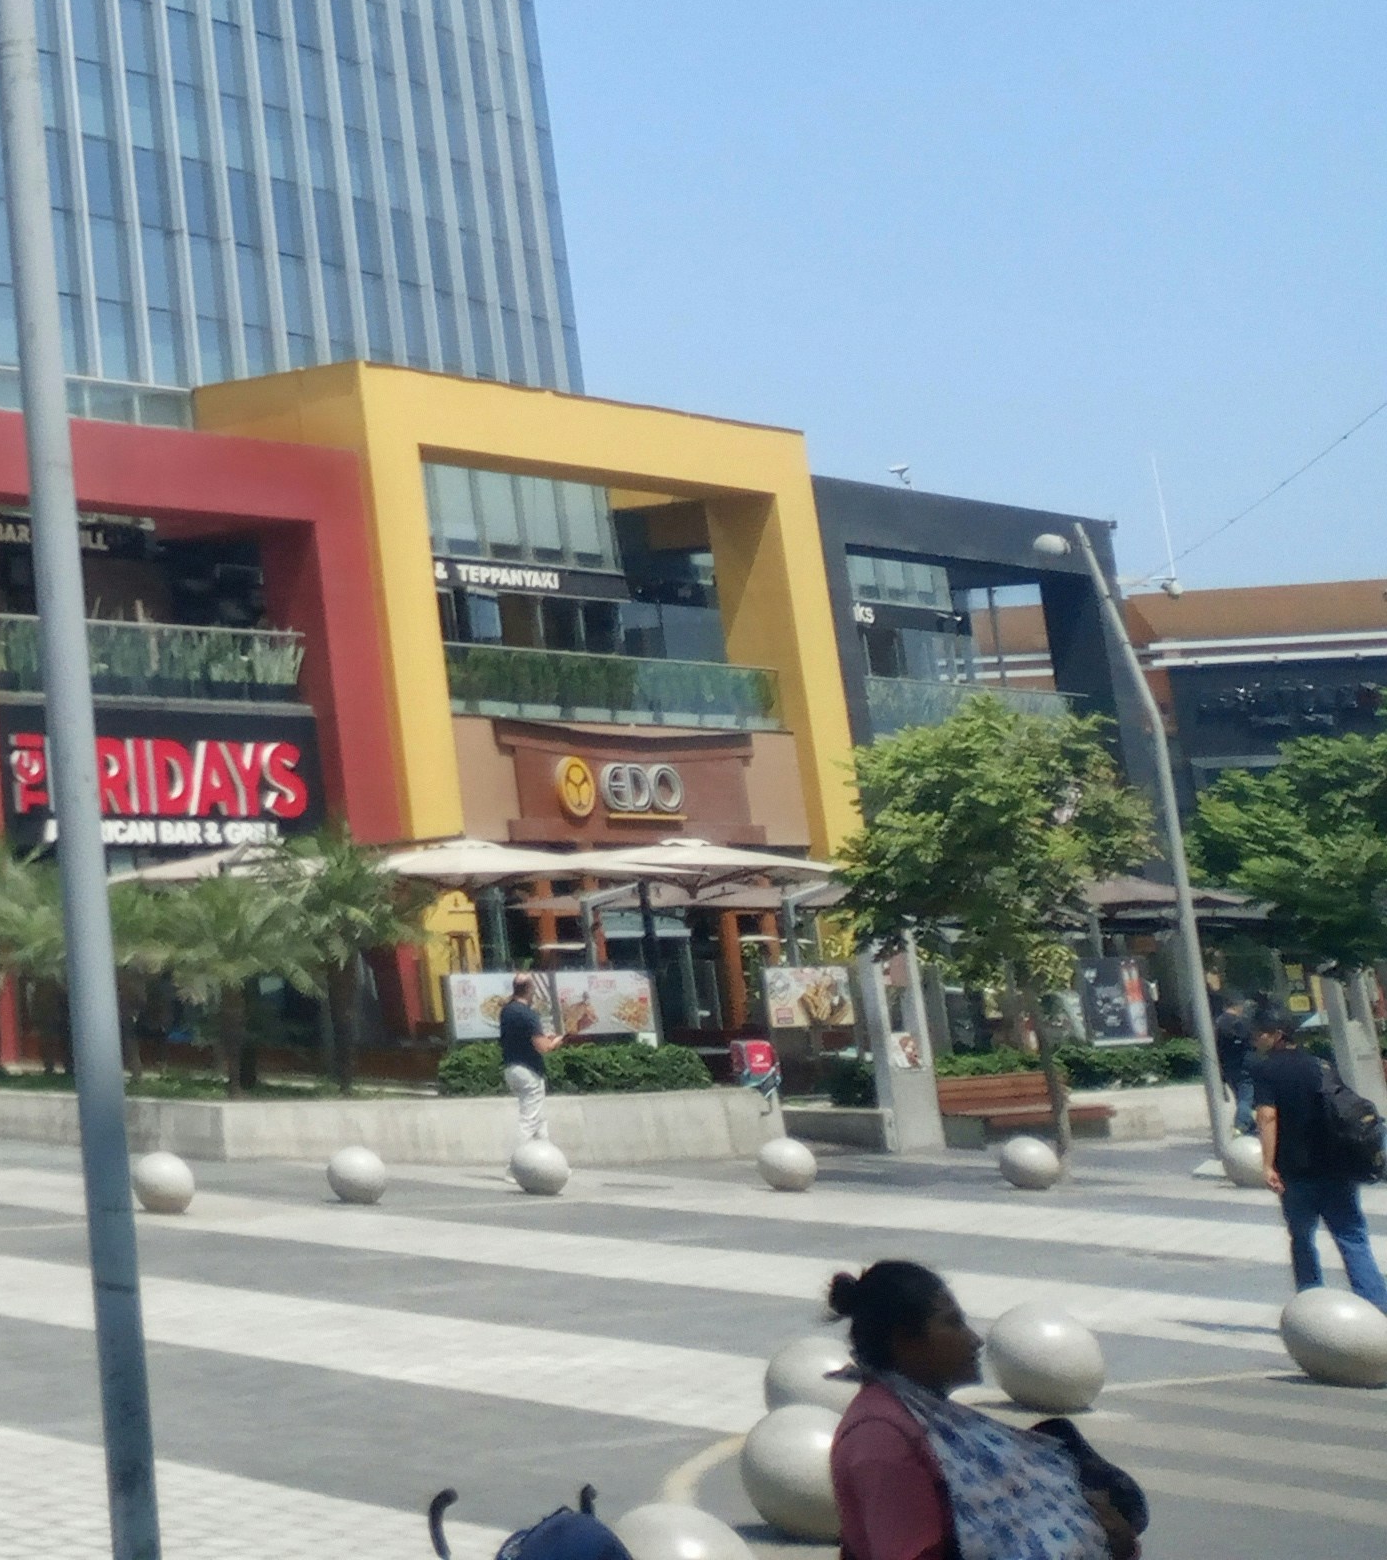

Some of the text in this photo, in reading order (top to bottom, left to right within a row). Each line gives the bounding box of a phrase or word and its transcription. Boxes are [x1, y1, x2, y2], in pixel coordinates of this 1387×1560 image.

[456, 563, 560, 589] TEPPANYAKI
[94, 736, 308, 819] RIDAYS
[600, 762, 685, 812] EDO
[158, 820, 203, 843] BAR
[203, 821, 223, 843] &
